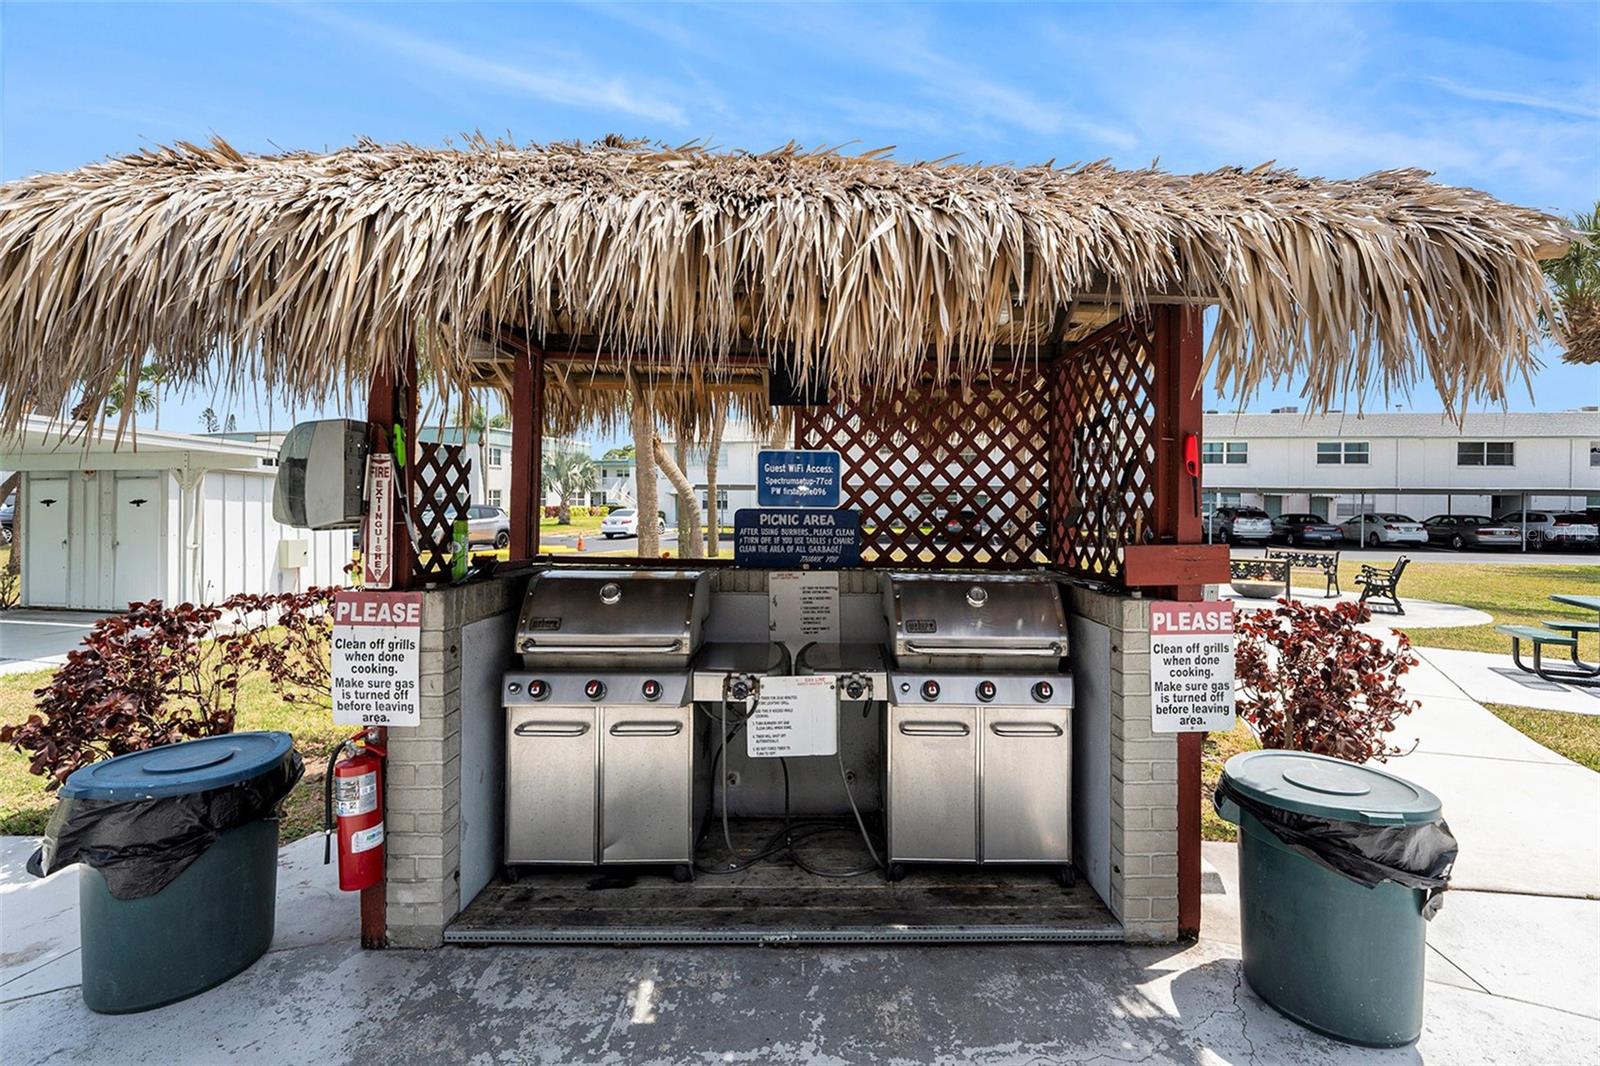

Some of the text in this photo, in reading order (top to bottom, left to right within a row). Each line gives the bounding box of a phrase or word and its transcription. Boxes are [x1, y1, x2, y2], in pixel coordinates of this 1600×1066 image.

[370, 466, 390, 478] FIRE
[764, 463, 834, 474] Guest WiFi Access:
[760, 514, 836, 525] PICNIC AREA
[374, 480, 383, 576] EXTINGUISHER
[833, 537, 854, 545] CHAIRS
[739, 545, 756, 553] CLEAN
[758, 545, 768, 553] THE
[808, 544, 842, 554] GARBAGE!
[336, 602, 420, 622] PLEASE
[1152, 612, 1232, 631] PLEASE
[335, 638, 416, 652] Clean off grills
[1153, 643, 1230, 656] Clean off grills
[345, 651, 404, 662] when done
[1163, 655, 1220, 665] when done
[351, 664, 398, 676] cooking.
[1170, 667, 1214, 679] cooking.
[336, 678, 415, 691] Make sure gas
[1155, 682, 1182, 691] Make
[1211, 683, 1230, 694] gas
[342, 690, 409, 700] is turned off
[1160, 692, 1224, 702] is turned off
[337, 702, 414, 714] before leaving
[1156, 704, 1230, 715] before leaving
[362, 714, 390, 723] area.
[1180, 717, 1206, 725] area.
